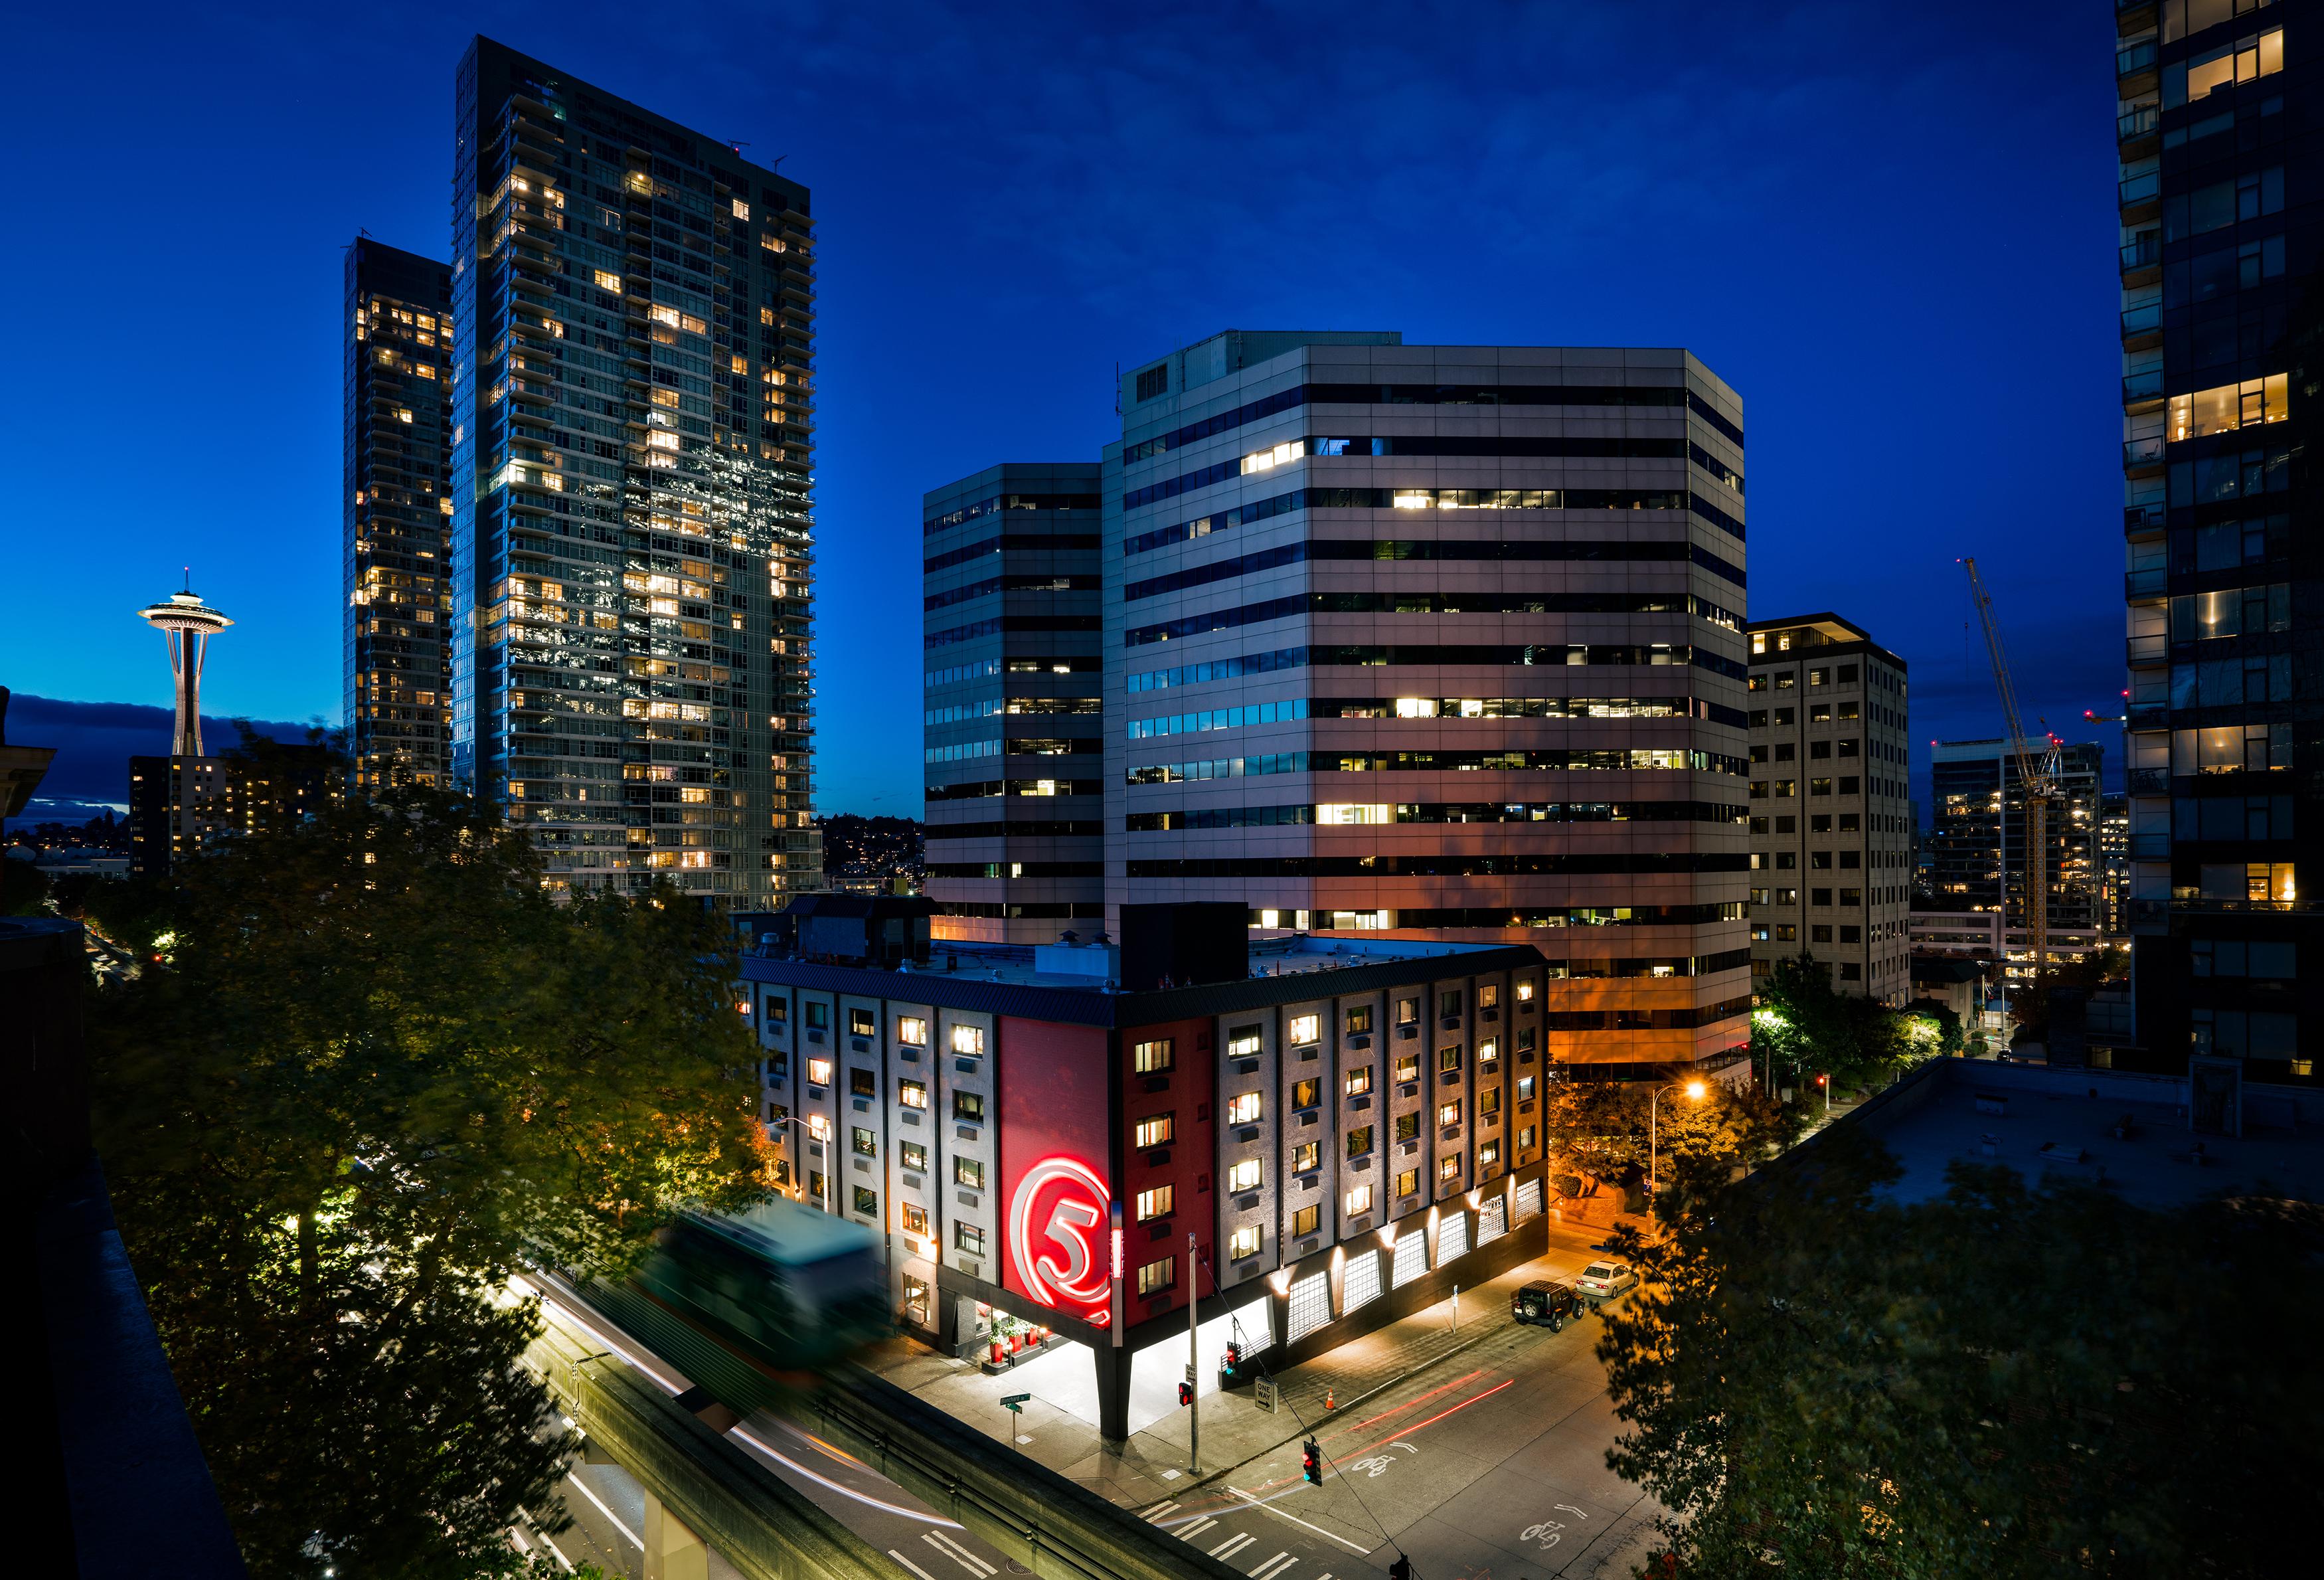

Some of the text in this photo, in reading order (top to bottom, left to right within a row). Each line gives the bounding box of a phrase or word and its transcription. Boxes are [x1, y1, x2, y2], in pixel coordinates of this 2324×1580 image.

[1036, 1197, 1100, 1288] 5
[1258, 1383, 1270, 1393] ONE
[1258, 1390, 1270, 1401] WAY
